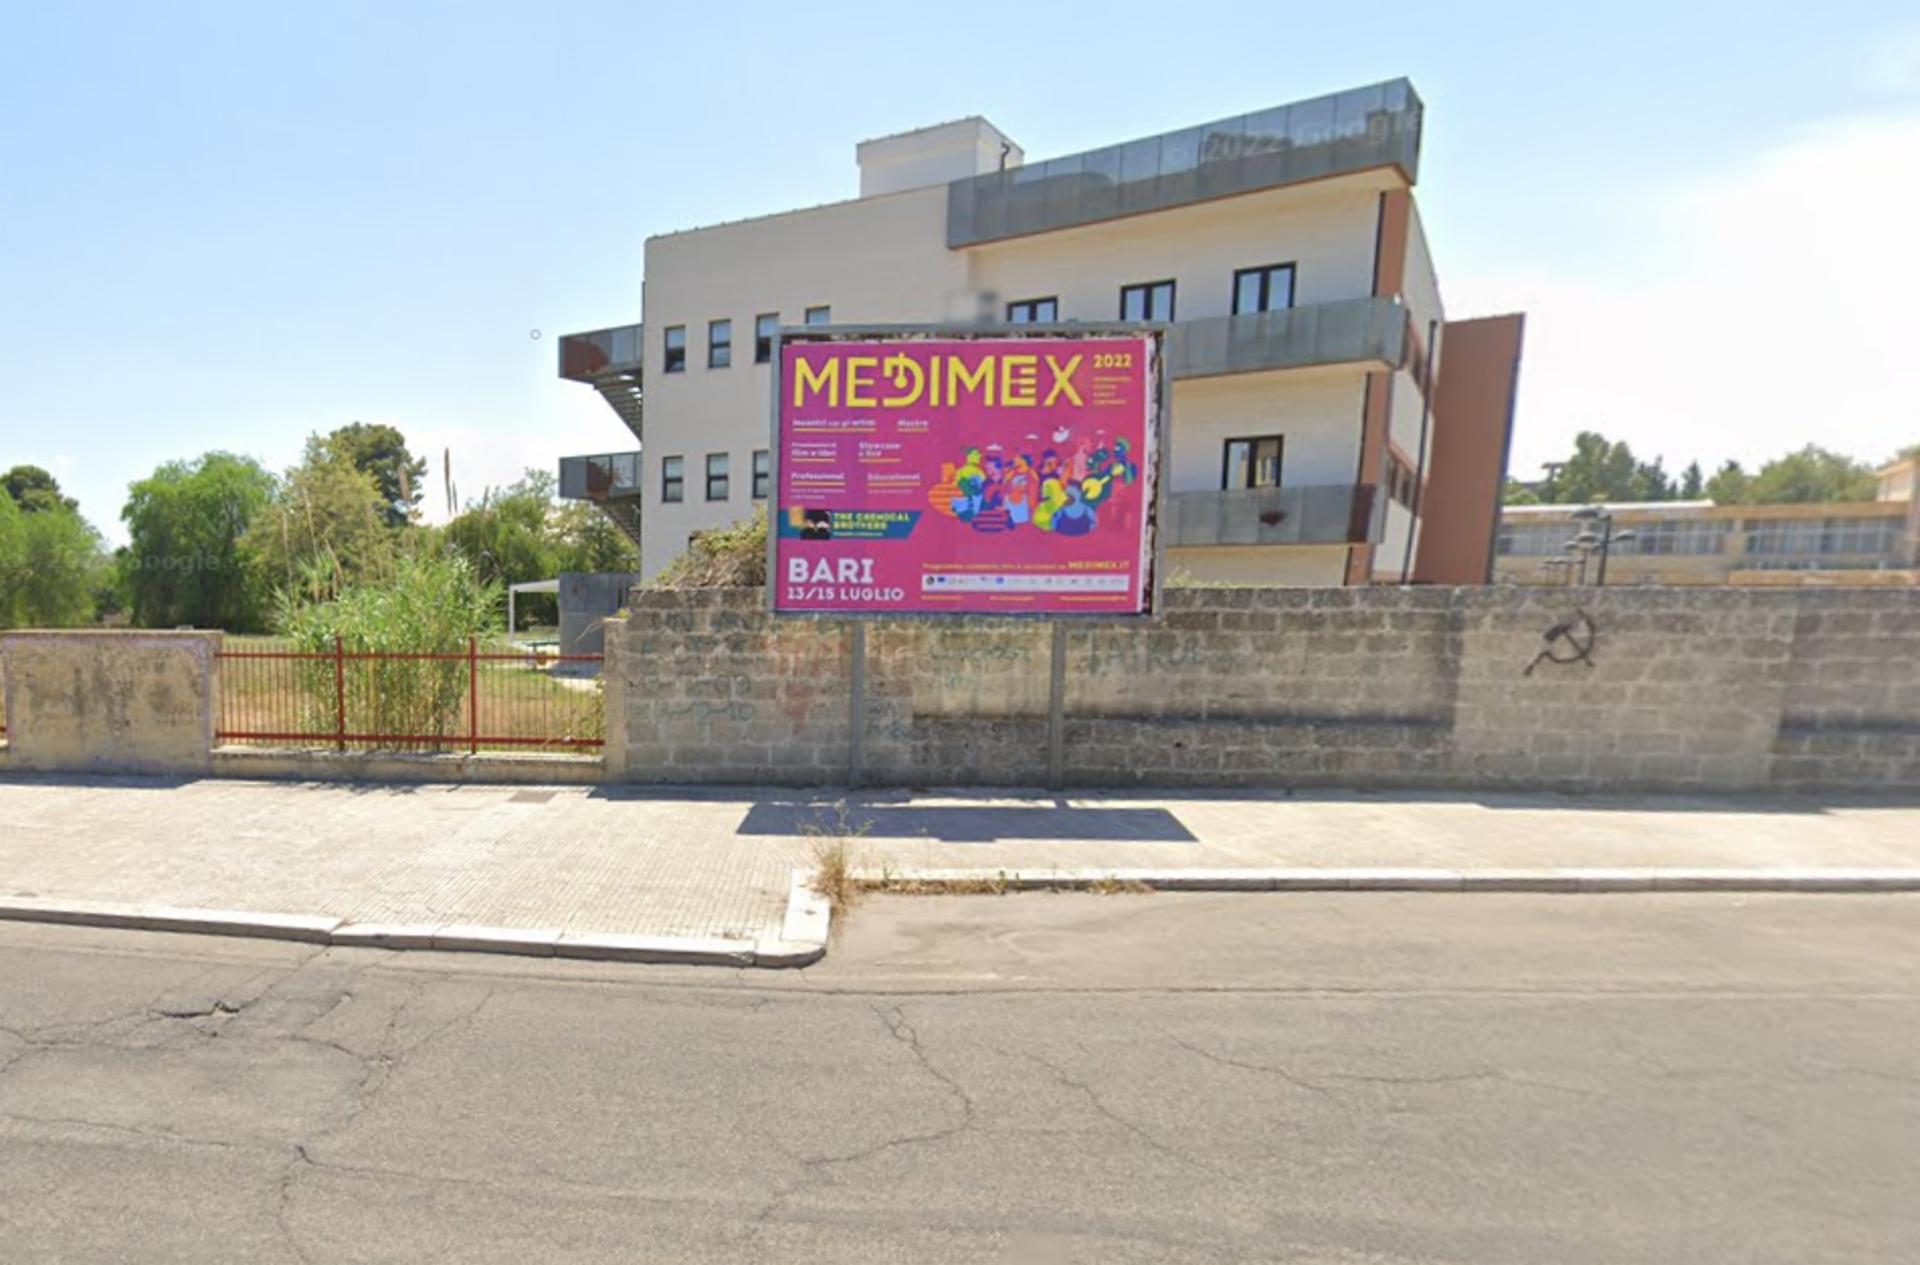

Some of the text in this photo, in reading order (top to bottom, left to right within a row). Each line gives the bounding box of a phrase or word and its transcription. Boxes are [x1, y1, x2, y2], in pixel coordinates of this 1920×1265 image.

[1093, 352, 1132, 369] 2022
[793, 352, 1084, 407] MEDIMEX
[833, 511, 910, 522] THE CHEMICAL
[833, 521, 888, 530] BROTHERS
[788, 557, 875, 583] BARI
[787, 586, 904, 601] 13/15 LUGLIO
